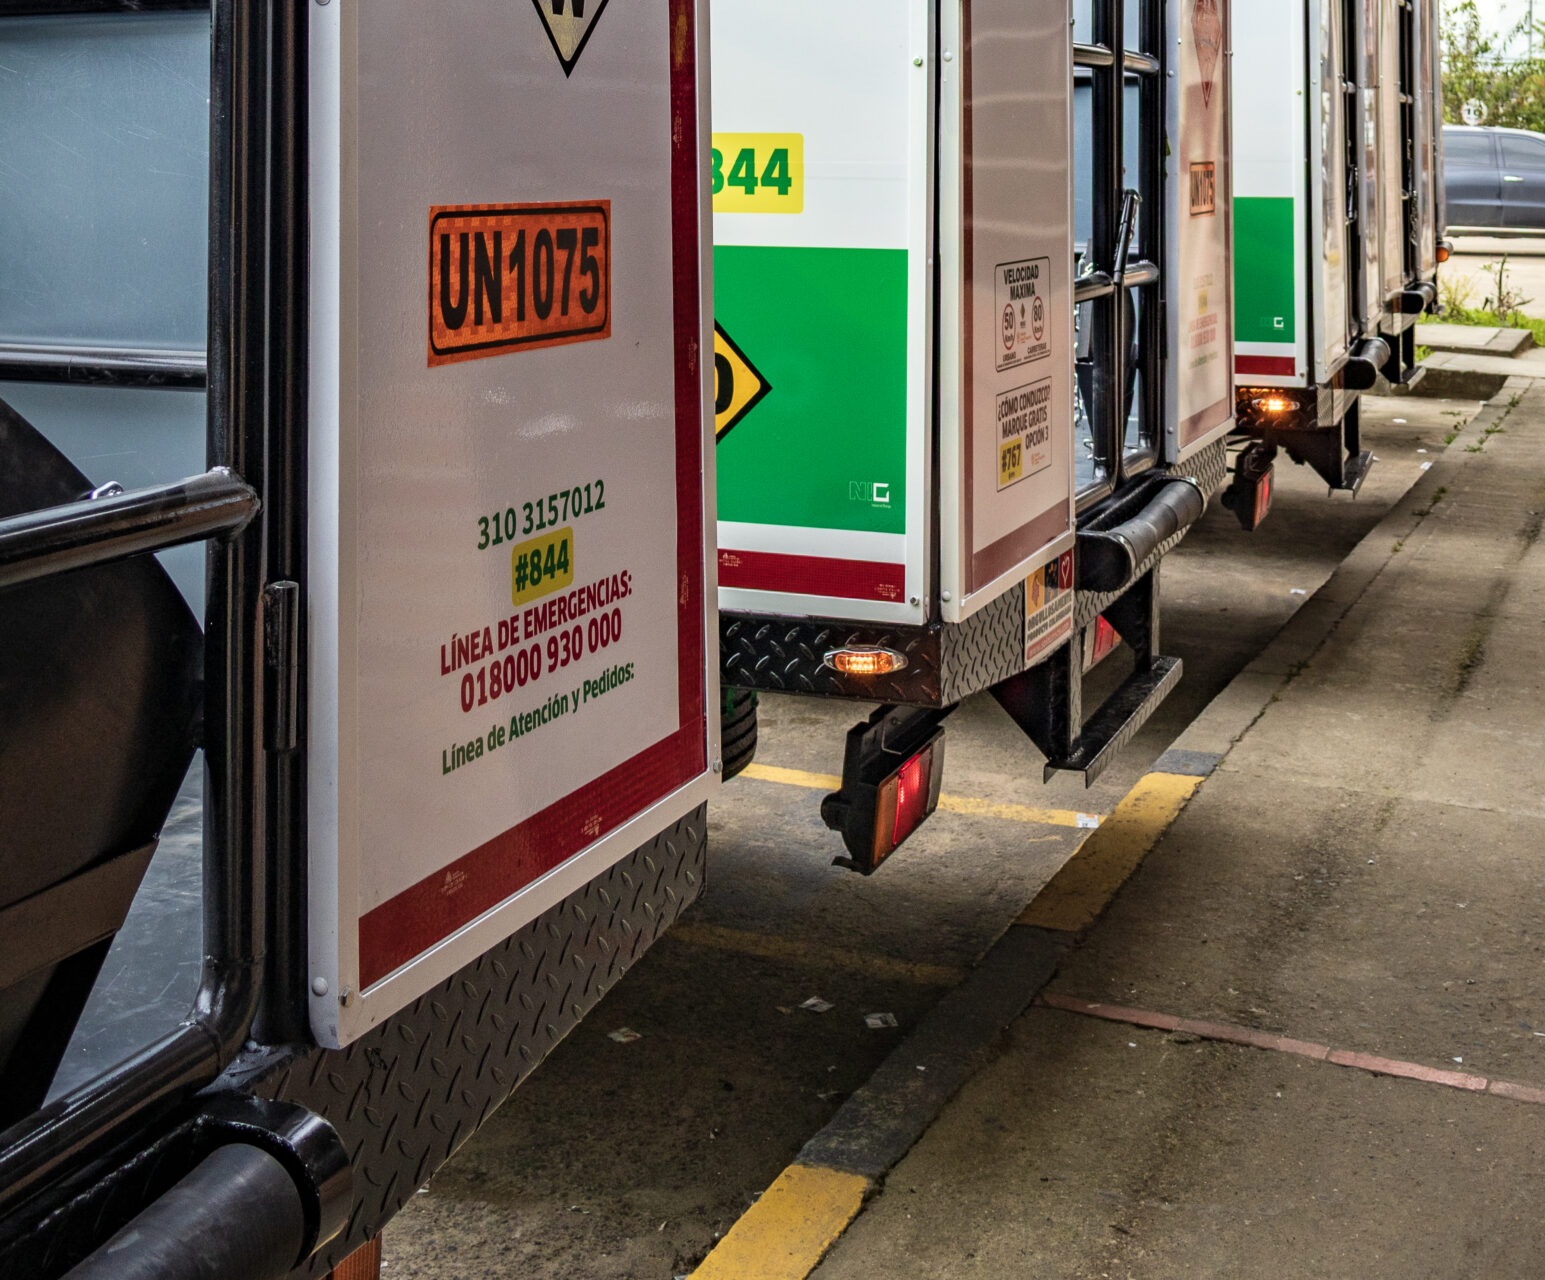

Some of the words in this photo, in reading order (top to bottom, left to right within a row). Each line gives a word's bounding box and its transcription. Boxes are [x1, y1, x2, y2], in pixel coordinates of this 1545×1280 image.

[440, 227, 600, 331] UN1075
[1003, 264, 1039, 285] VELOCIDAD
[1004, 311, 1014, 331] 50
[1033, 303, 1043, 323] 80
[998, 396, 1018, 422] ¿CÓMO
[1019, 384, 1051, 411] CONDUZCO?
[1002, 412, 1028, 439] MARQUE
[1028, 405, 1048, 428] GRATIS
[1025, 426, 1044, 450] OPCIÓN
[1045, 425, 1049, 441] 3
[1001, 443, 1021, 473] #767
[477, 506, 516, 551] 310
[522, 479, 606, 535] 3157012
[515, 538, 569, 593] #844
[441, 626, 493, 676] LÍNEA
[498, 614, 520, 651] DE
[524, 569, 633, 641] EMERGENCIAS:
[460, 643, 541, 713] 018000
[547, 624, 583, 674] 930
[587, 607, 622, 654] 000
[442, 737, 484, 776] Línea
[487, 724, 506, 752] de
[508, 694, 569, 742] Atención
[571, 687, 580, 712] y
[583, 662, 634, 703] Pedidos:
